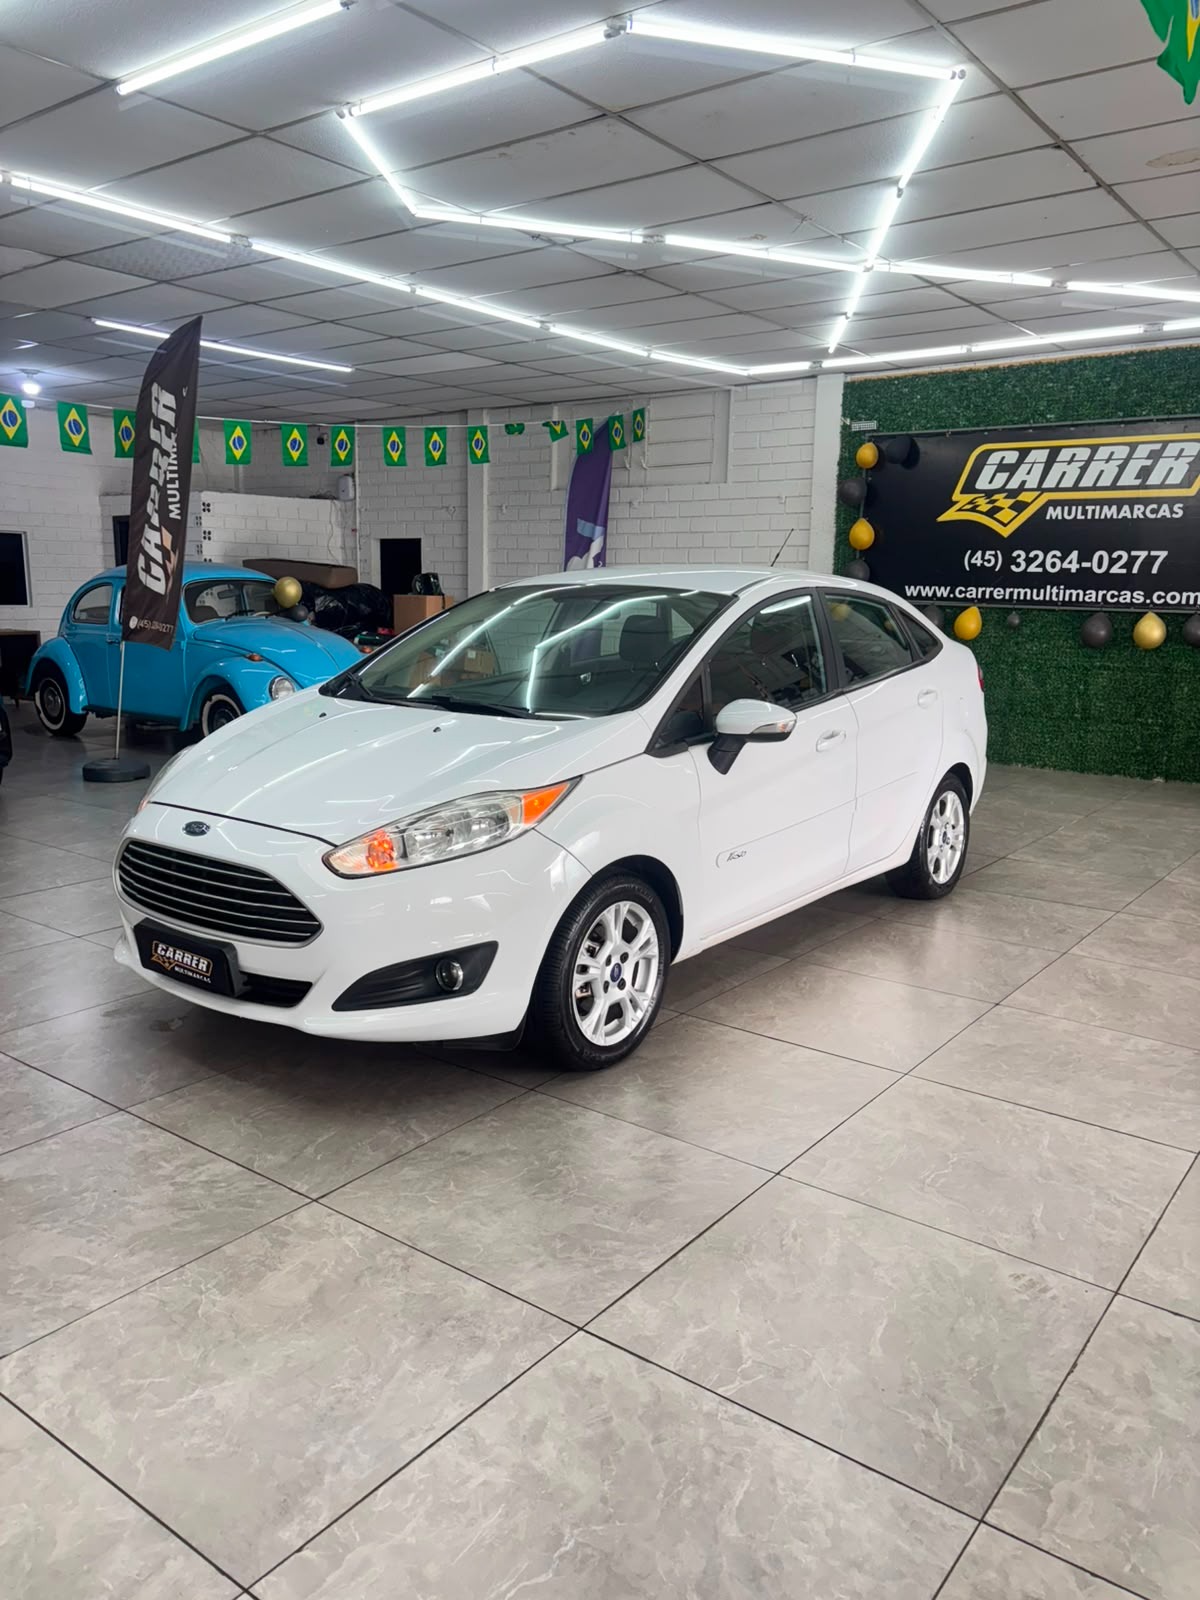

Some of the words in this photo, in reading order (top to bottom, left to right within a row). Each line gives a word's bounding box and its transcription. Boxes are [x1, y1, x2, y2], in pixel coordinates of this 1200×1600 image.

[975, 442, 1200, 490] CARRER
[1046, 503, 1184, 520] MULTIMARCAS
[964, 550, 1003, 571] (45)
[1010, 549, 1169, 575] 3264-0277
[905, 585, 1200, 605] www.carrermultimarcas.com
[157, 943, 208, 971] CARRER
